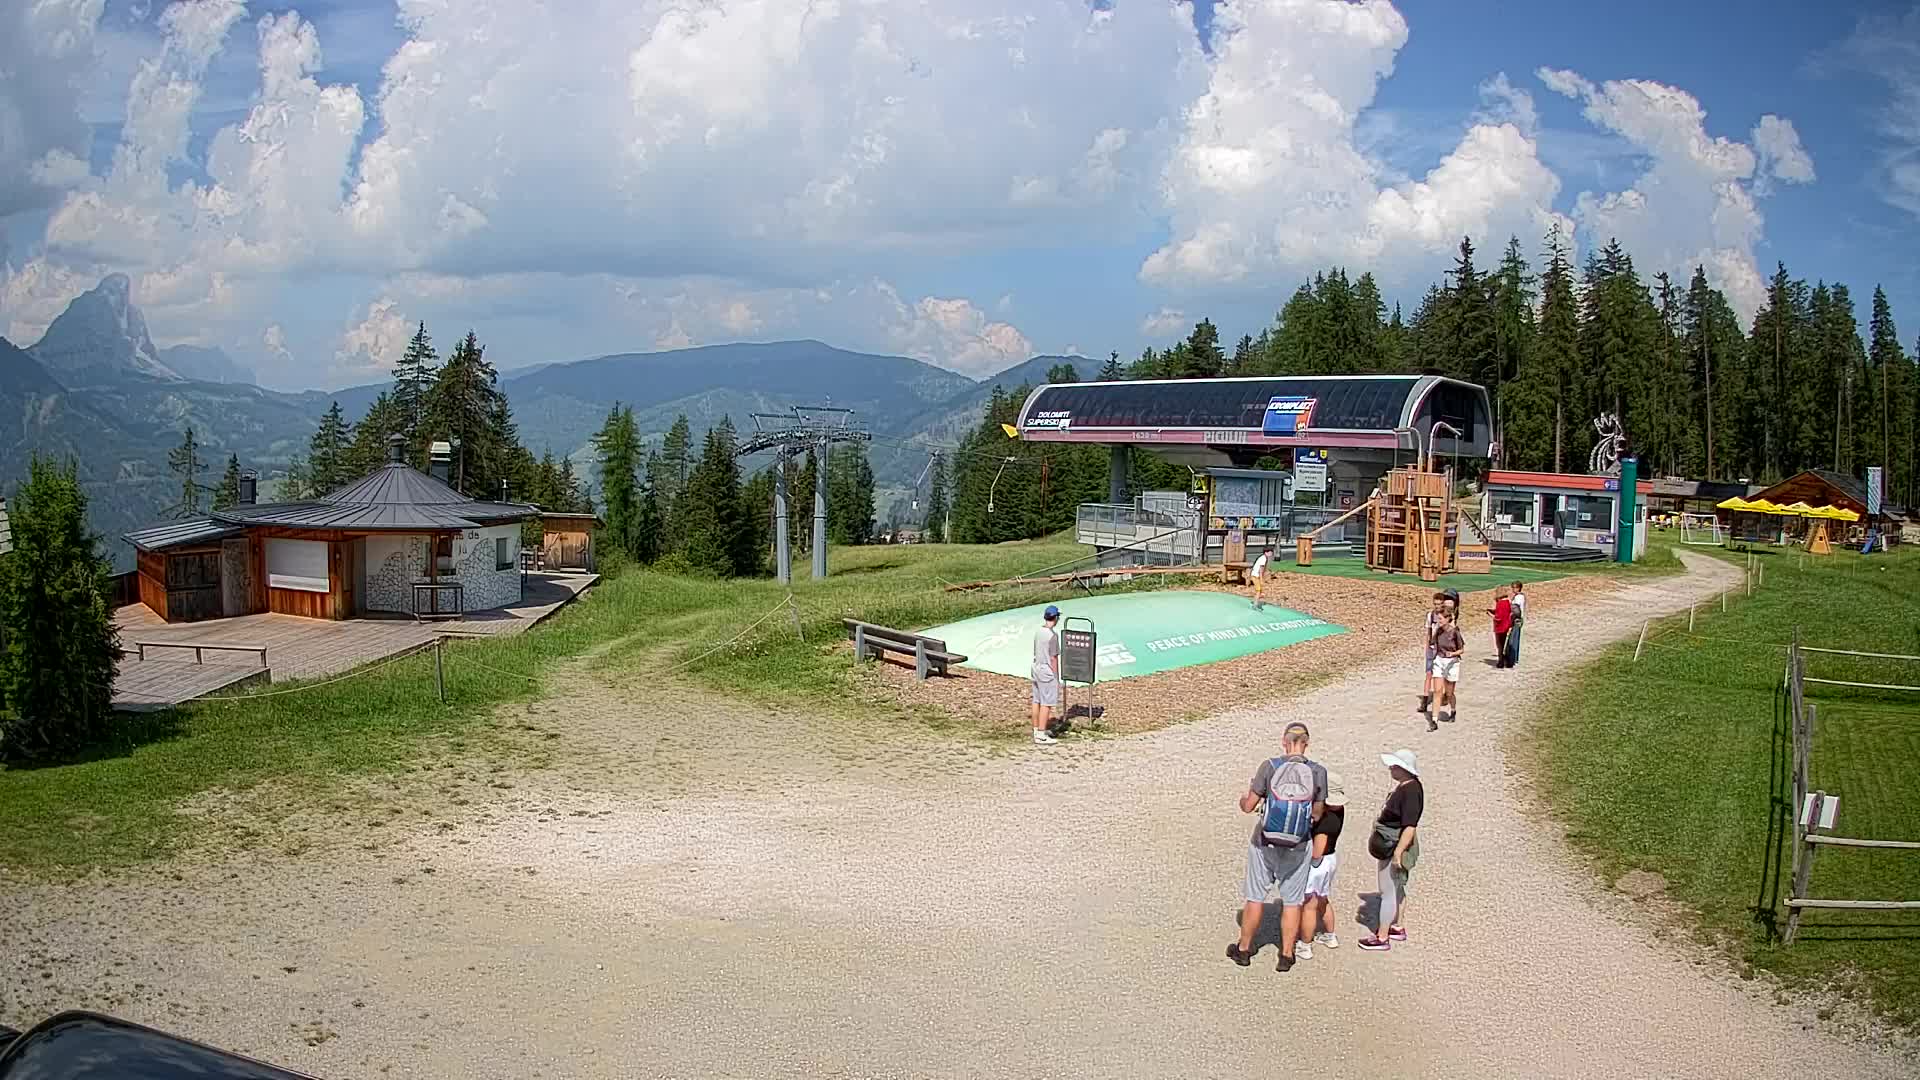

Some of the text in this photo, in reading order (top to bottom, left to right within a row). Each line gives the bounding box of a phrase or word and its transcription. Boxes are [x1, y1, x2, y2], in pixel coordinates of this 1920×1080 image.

[1027, 418, 1060, 426] SUPERSKI
[1146, 635, 1190, 653] PEACE
[1189, 632, 1206, 645] OF
[1206, 628, 1239, 641] MIND
[1236, 626, 1250, 638] IN
[1250, 624, 1271, 635] ALL
